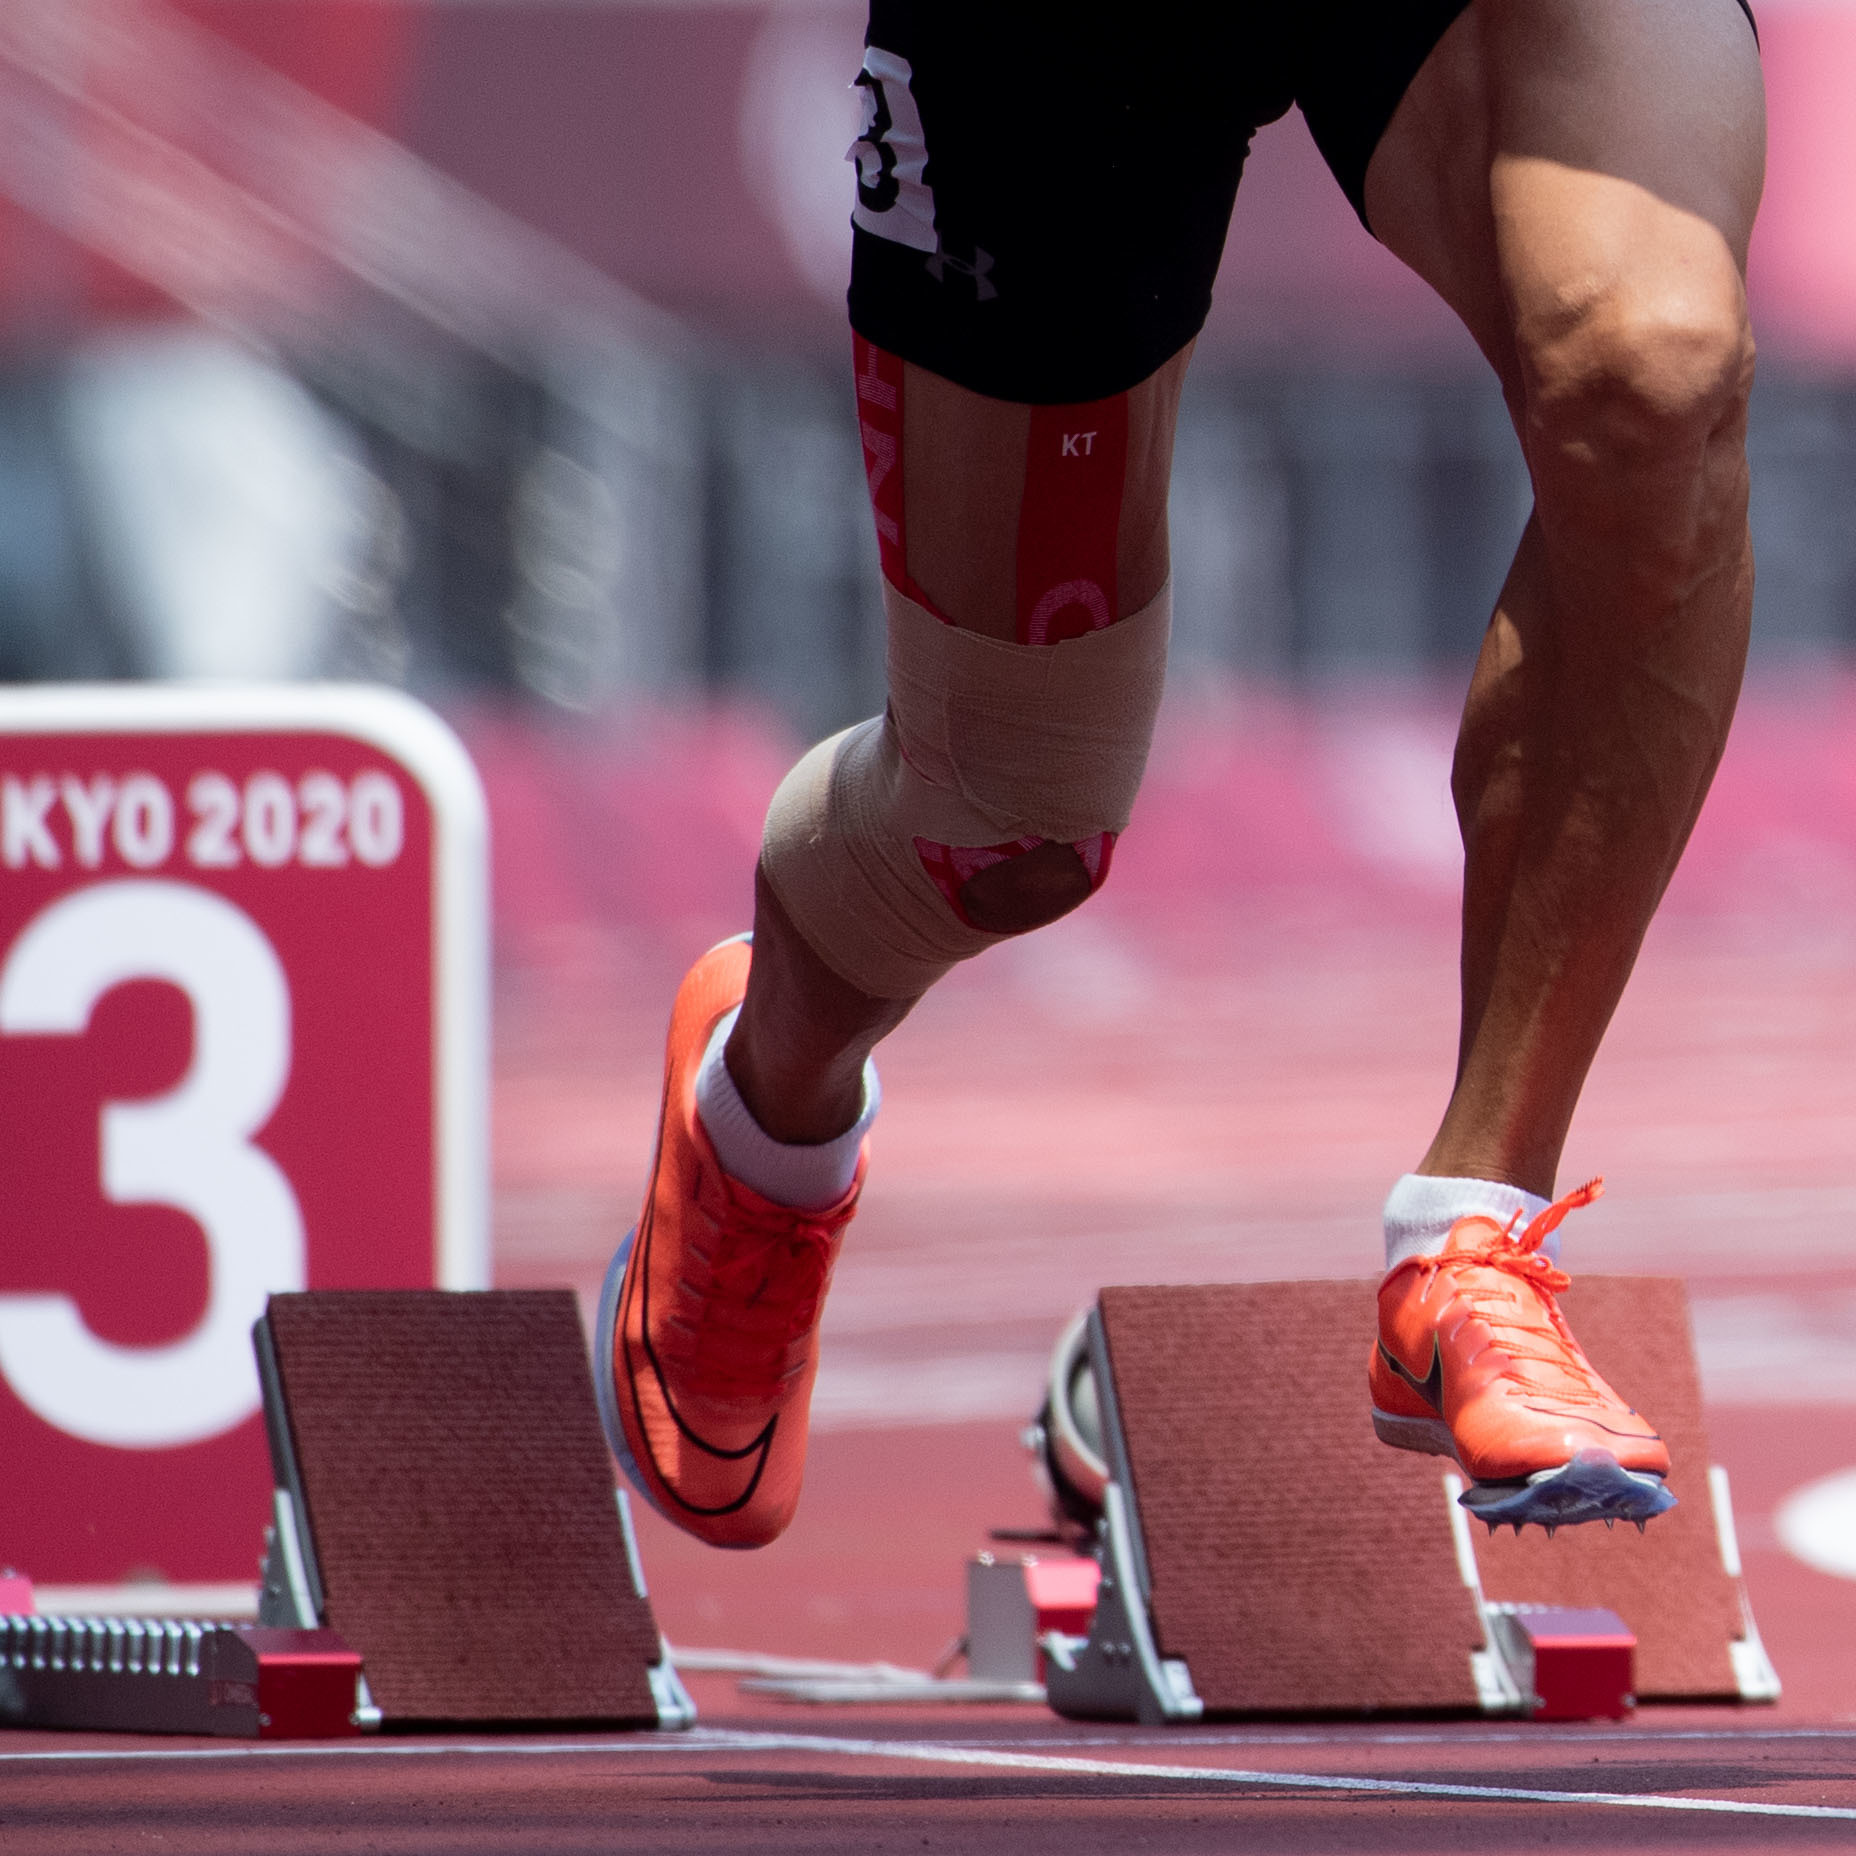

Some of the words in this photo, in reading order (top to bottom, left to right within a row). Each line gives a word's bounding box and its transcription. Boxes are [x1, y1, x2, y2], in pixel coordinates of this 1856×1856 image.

[1062, 431, 1098, 457] KT
[186, 767, 404, 870] 2020
[0, 879, 308, 1451] 3
